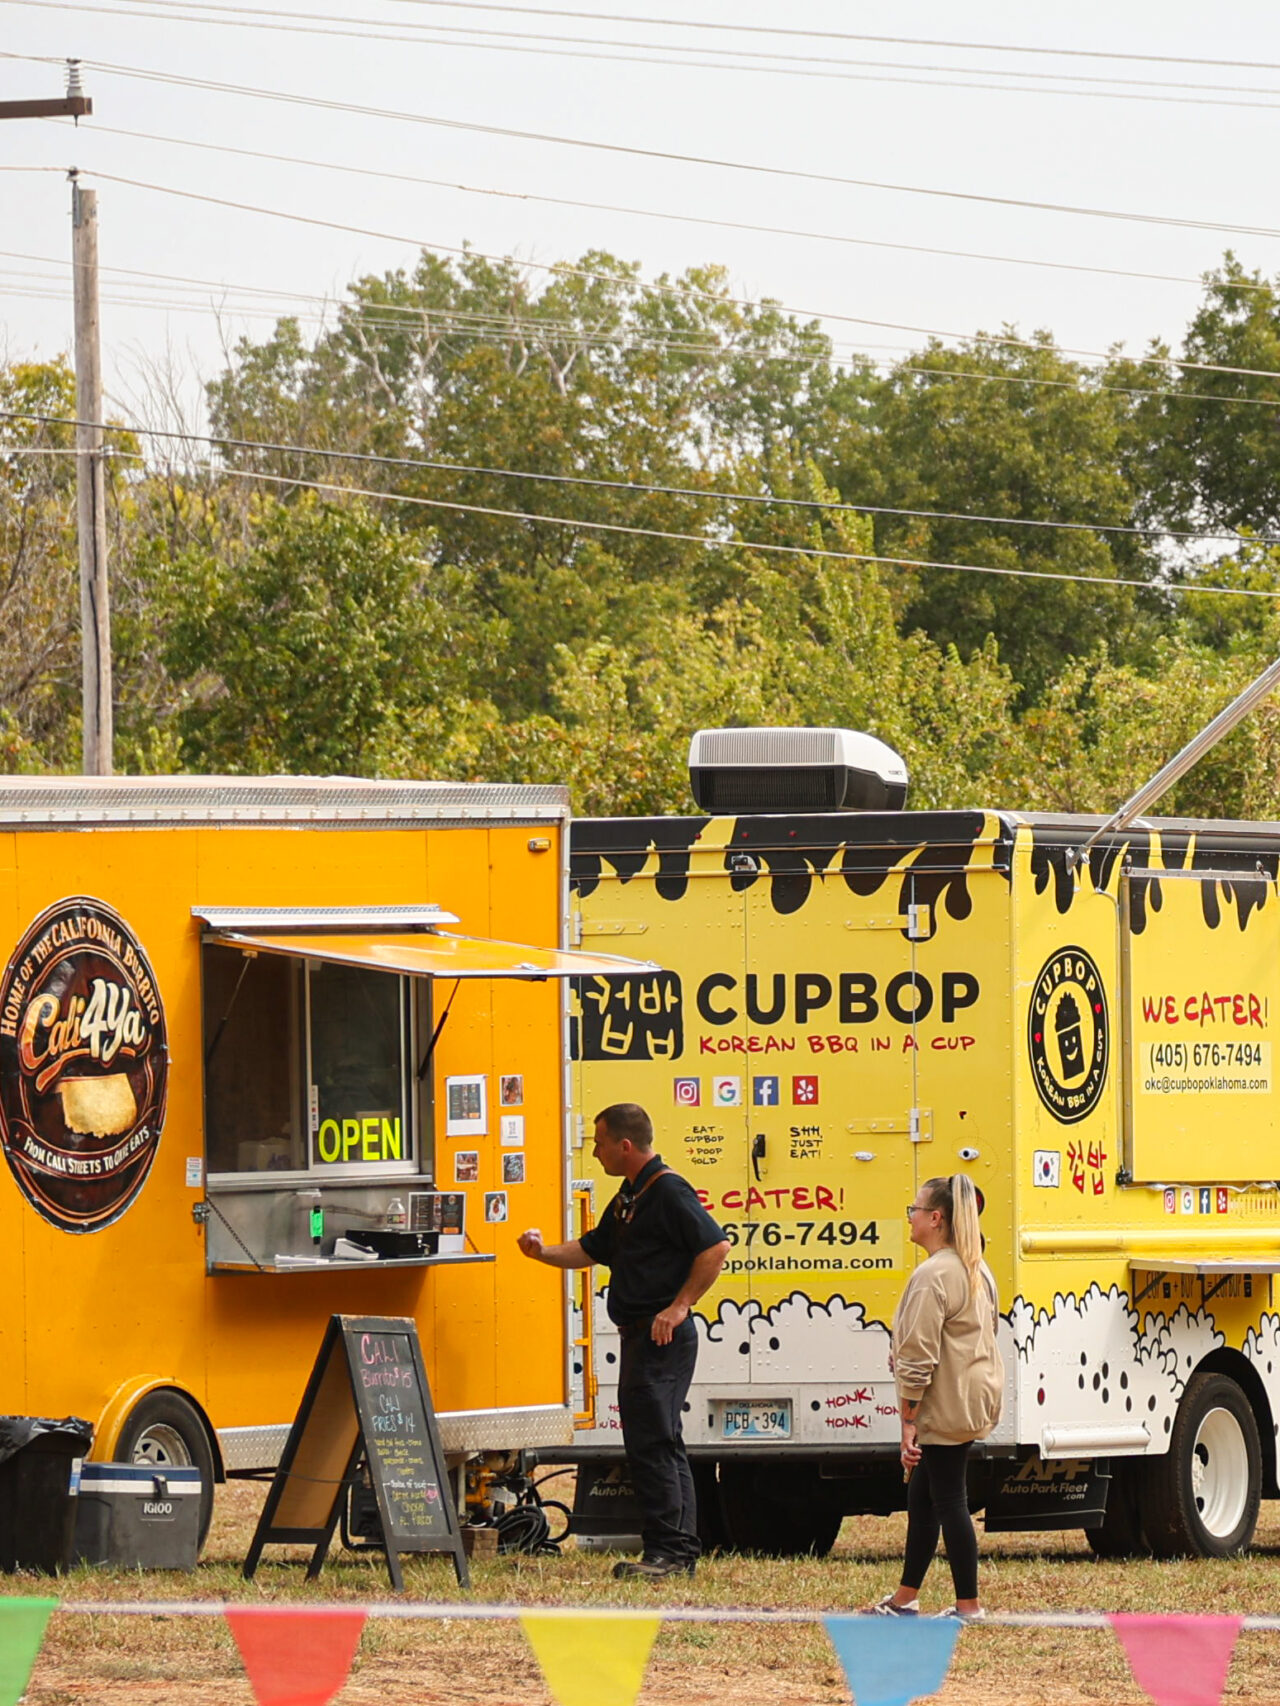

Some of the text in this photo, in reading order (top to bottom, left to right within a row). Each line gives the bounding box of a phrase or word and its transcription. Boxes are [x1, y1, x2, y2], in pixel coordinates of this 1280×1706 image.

[1, 976, 26, 1037] HOME
[20, 957, 35, 982] OF
[32, 935, 53, 965] THE
[123, 942, 160, 1025] BURRITO
[1035, 957, 1097, 1015] CUPBOP
[696, 971, 980, 1025] CUPBOP
[1142, 991, 1268, 1029] WE CATER!
[700, 1034, 976, 1054] KOREAN BBQ IN A CUP
[1150, 1043, 1262, 1073] (405) 676-7494
[1037, 1056, 1065, 1106] KOREAN
[1067, 1093, 1086, 1108] BBQ
[1086, 1081, 1095, 1097] IN
[1093, 1069, 1099, 1081] A
[1145, 1076, 1268, 1093] okc@cupbopoklahoma.com
[318, 1117, 400, 1163] OPEN
[684, 1135, 724, 1143] CUPBOP
[692, 1126, 716, 1134] EAT
[24, 1136, 46, 1162] FROM
[46, 1151, 67, 1172] CALI
[67, 1158, 102, 1174] STREETS
[103, 1156, 114, 1171] TO
[130, 1125, 150, 1153] EATS
[696, 1147, 723, 1155] POOP
[790, 1139, 823, 1148] JUST
[691, 1157, 717, 1165] GOLD
[790, 1149, 821, 1159] EAT!
[696, 1186, 844, 1213] E CATER!
[722, 1221, 880, 1246] 676-7494
[721, 1256, 893, 1273] opoklahoma.com
[361, 1333, 399, 1364] CALI
[825, 1387, 876, 1409] HONK!
[875, 1404, 900, 1417] HON
[372, 1414, 397, 1433] FRIES
[825, 1414, 872, 1429] HONK!
[1009, 1455, 1093, 1480] APF
[589, 1485, 617, 1496] Auto
[1001, 1482, 1088, 1494] Auto Park Fleet
